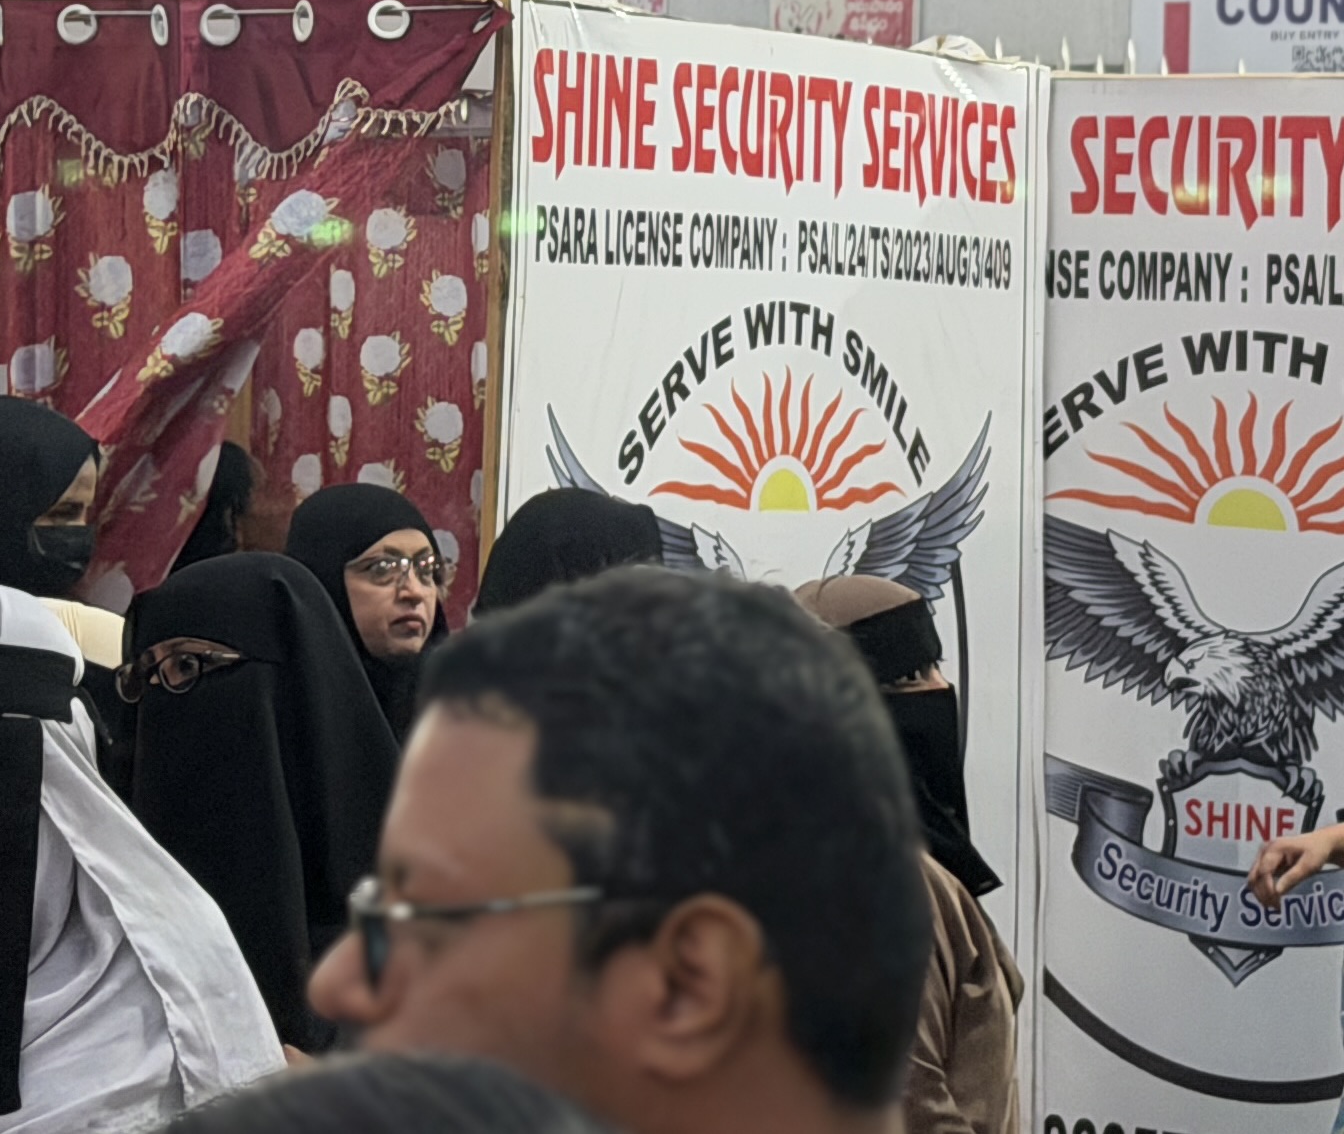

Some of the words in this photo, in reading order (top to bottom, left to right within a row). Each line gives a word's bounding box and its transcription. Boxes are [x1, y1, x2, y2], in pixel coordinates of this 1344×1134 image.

[1270, 31, 1296, 41] BUY
[1299, 30, 1339, 41] ENTRY
[532, 48, 658, 181] SHINE
[672, 62, 853, 199] SECURITY
[863, 84, 1017, 208] SERVICES
[535, 204, 598, 265] PSARA
[604, 208, 683, 267] LICENSE
[797, 219, 1012, 291] PSA/L/24/TS/2023/AUG/3/409
[618, 315, 735, 485] SERVE
[743, 301, 835, 357] WITH
[842, 328, 932, 487] SMILE
[1180, 329, 1330, 385] WITH
[1184, 798, 1295, 843] SHINE
[1096, 841, 1229, 933] Security
